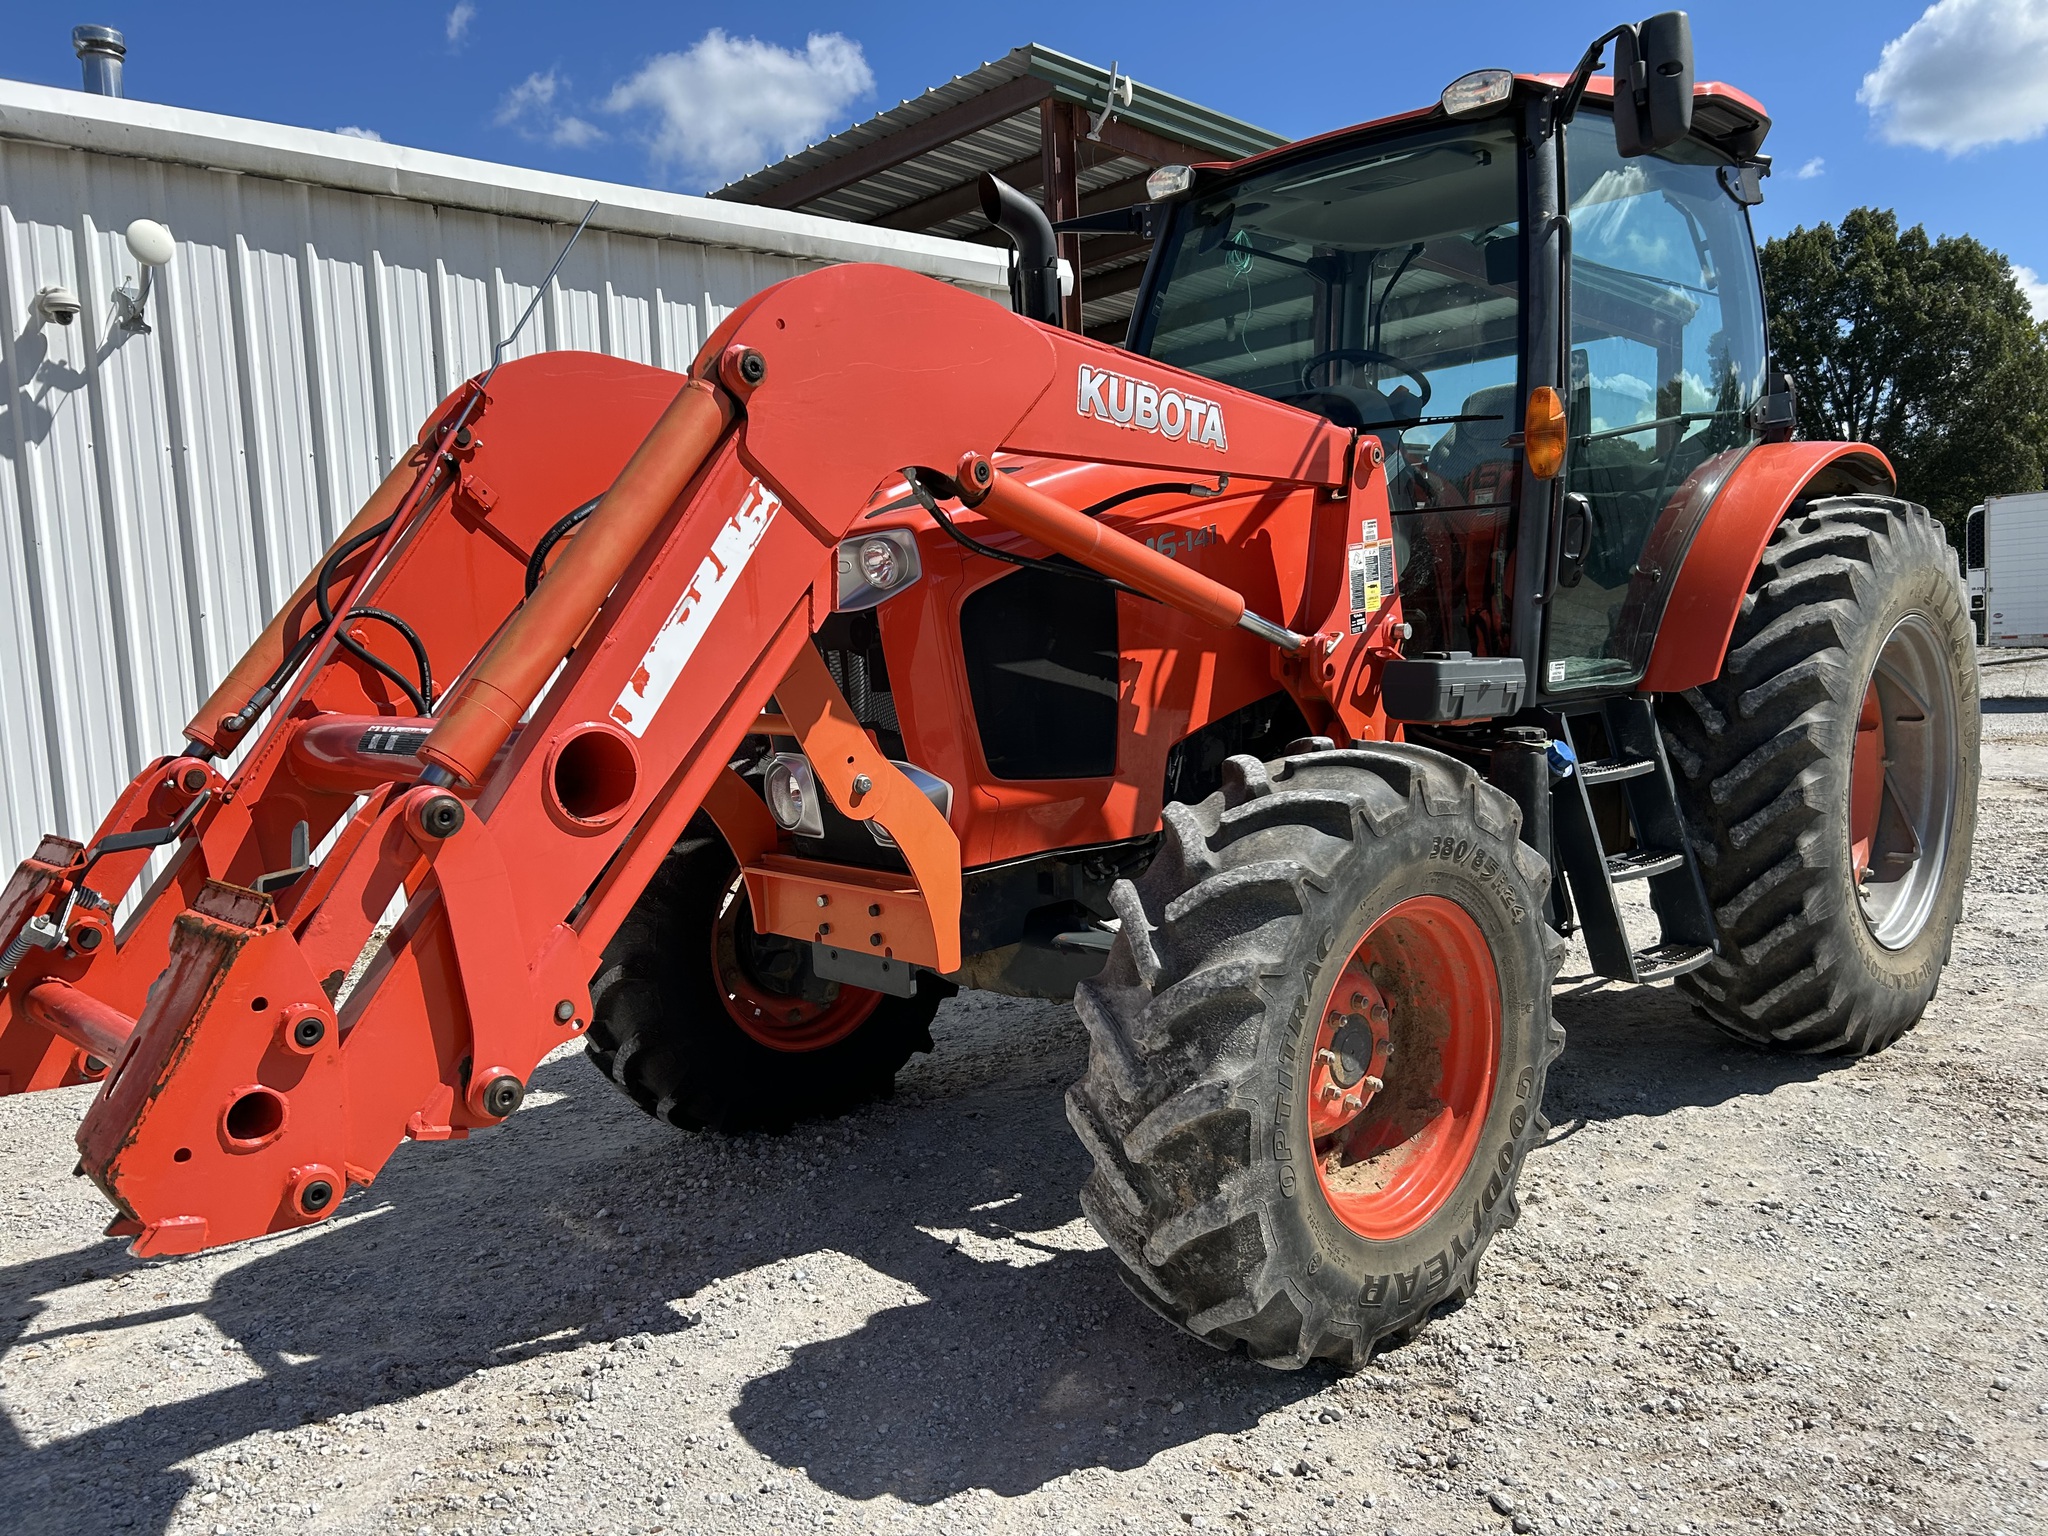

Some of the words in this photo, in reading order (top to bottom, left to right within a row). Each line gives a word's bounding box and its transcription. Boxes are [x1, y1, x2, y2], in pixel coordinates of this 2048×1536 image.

[1079, 365, 1227, 451] KUBOTA
[1923, 565, 1977, 703] TITAN
[1429, 836, 1526, 926] 380/85R24
[1863, 950, 1932, 990] HI-TRACTION
[1273, 925, 1335, 1199] OPTITRAC
